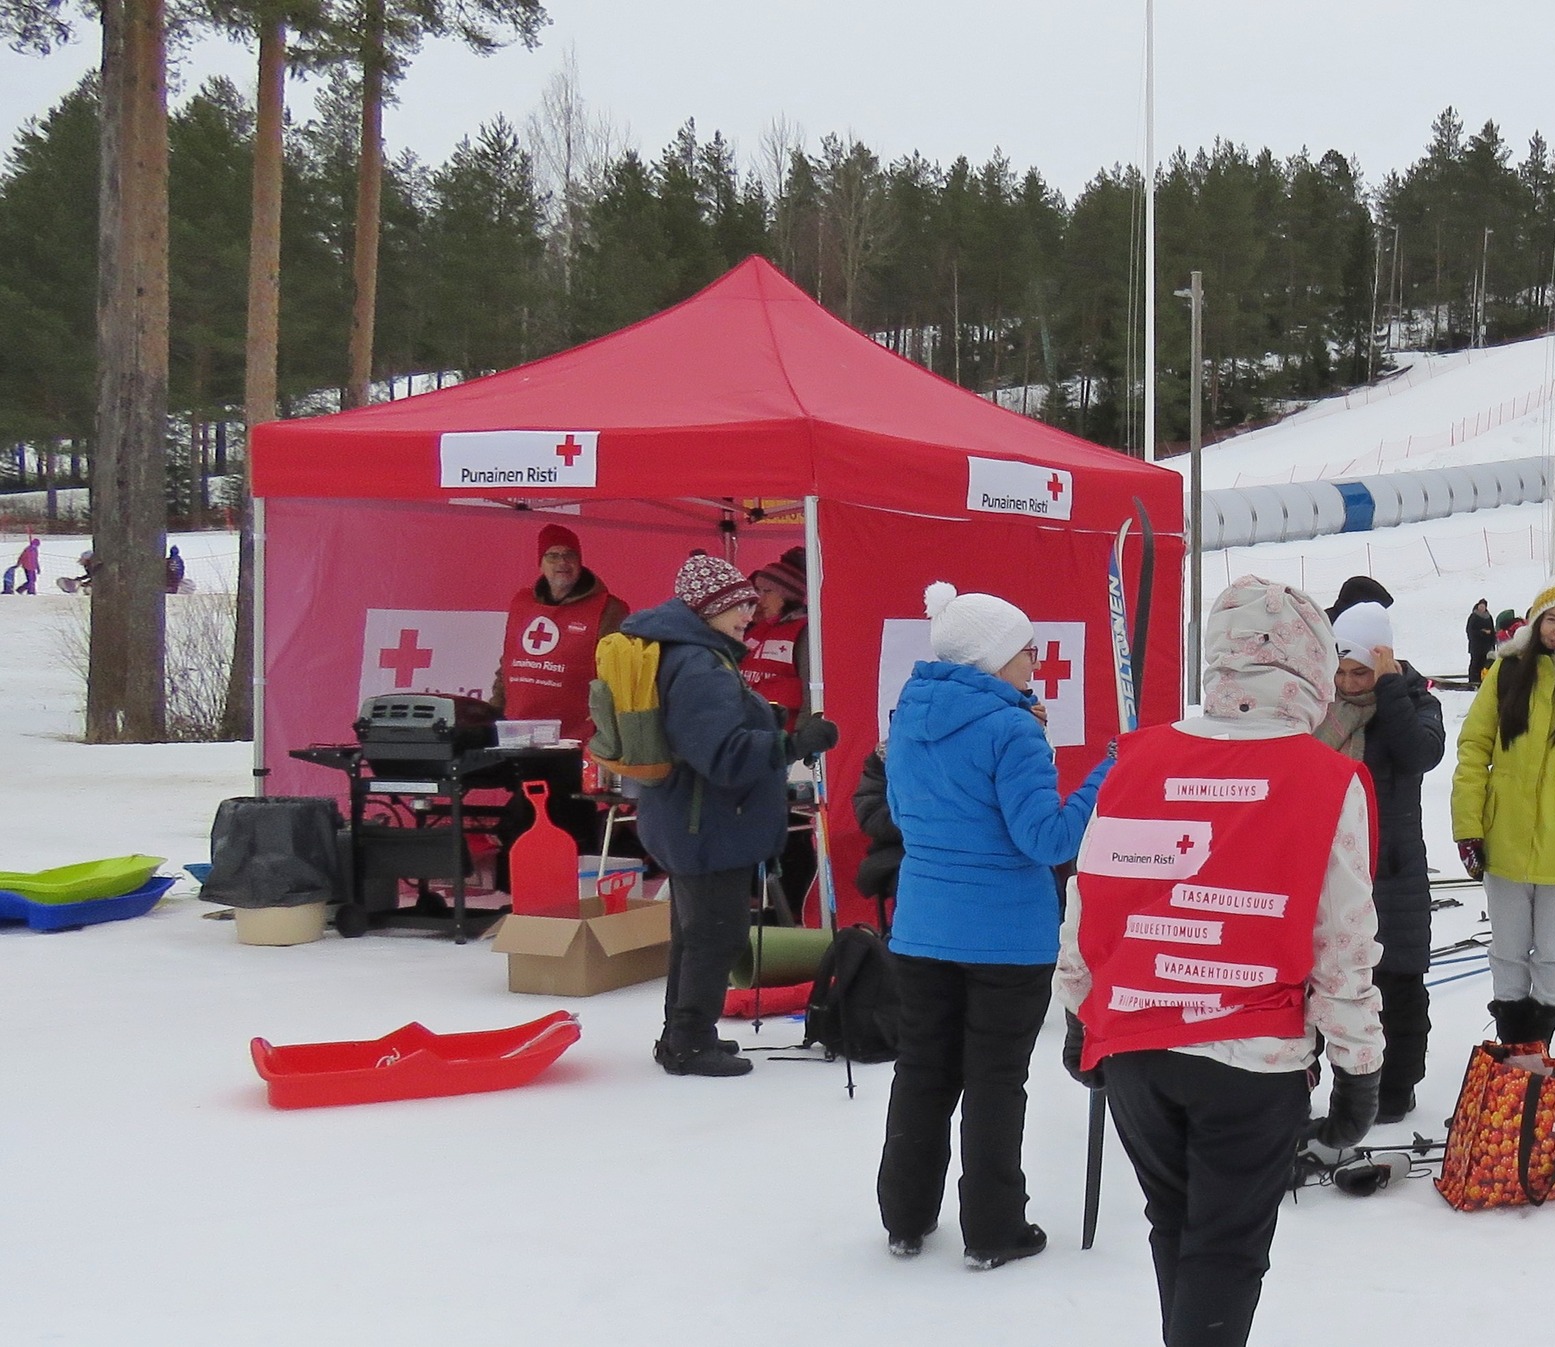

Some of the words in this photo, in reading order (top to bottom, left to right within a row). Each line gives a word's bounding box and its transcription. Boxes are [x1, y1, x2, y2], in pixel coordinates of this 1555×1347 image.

[461, 467, 524, 483] Punainen
[527, 467, 558, 483] Risti
[982, 493, 1028, 510] Punainen
[1029, 498, 1049, 514] Risti
[543, 660, 566, 673] Risti
[1176, 784, 1257, 797] INHIMILLISYYS
[1111, 851, 1152, 864] Punainen
[1153, 853, 1176, 865] Risti
[1181, 890, 1275, 910] TASAPUOLISUUS
[1163, 962, 1265, 982] VAPAAEHTOISUUS
